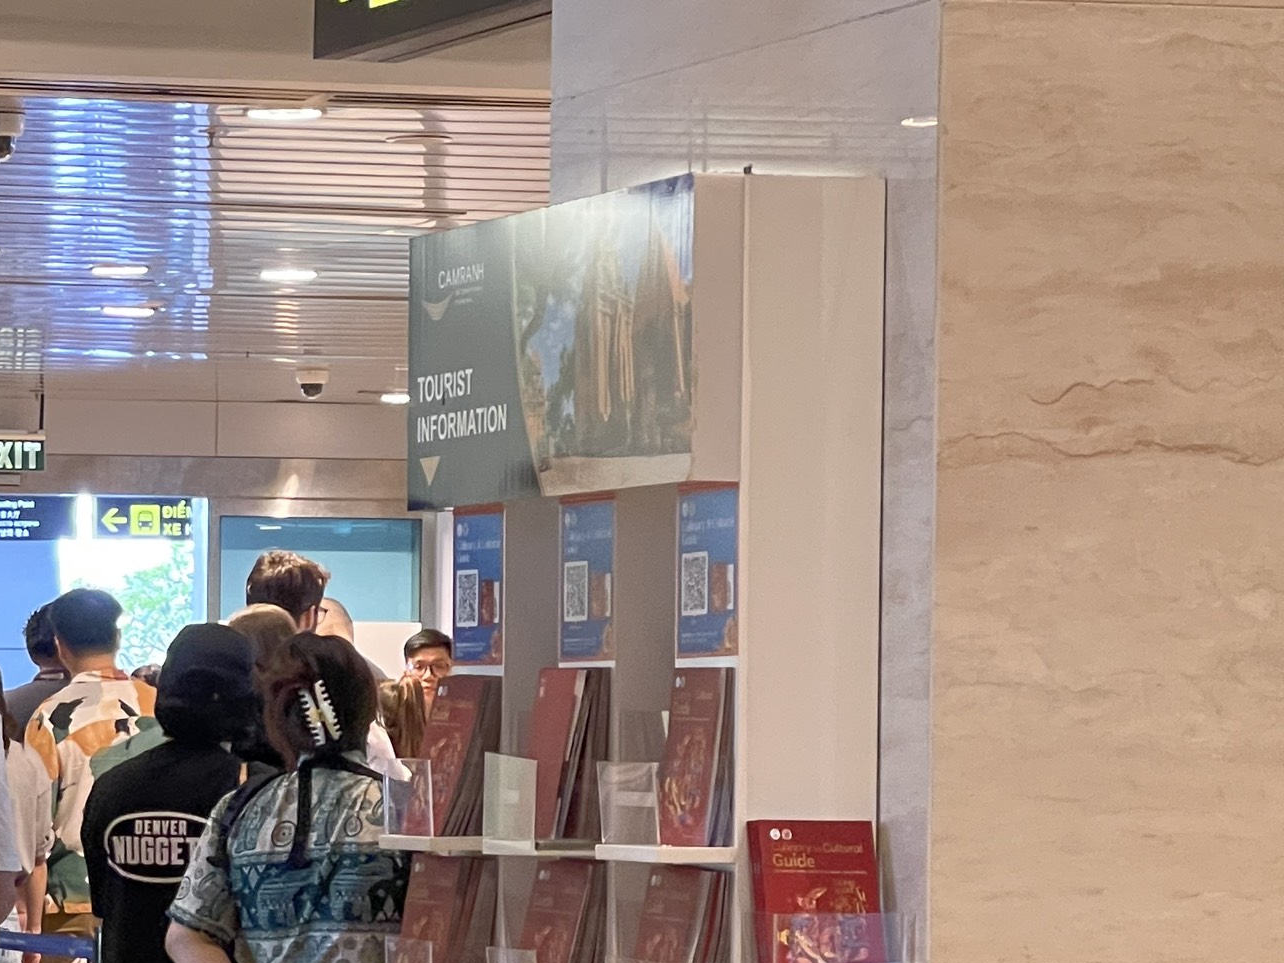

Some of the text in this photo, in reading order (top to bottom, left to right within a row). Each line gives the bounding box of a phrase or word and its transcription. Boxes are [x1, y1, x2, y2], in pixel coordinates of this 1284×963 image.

[417, 368, 473, 403] TOURIST
[417, 403, 507, 443] INFORMATION
[163, 523, 182, 536] XE
[134, 819, 187, 836] DENVER
[773, 853, 815, 868] Guide
